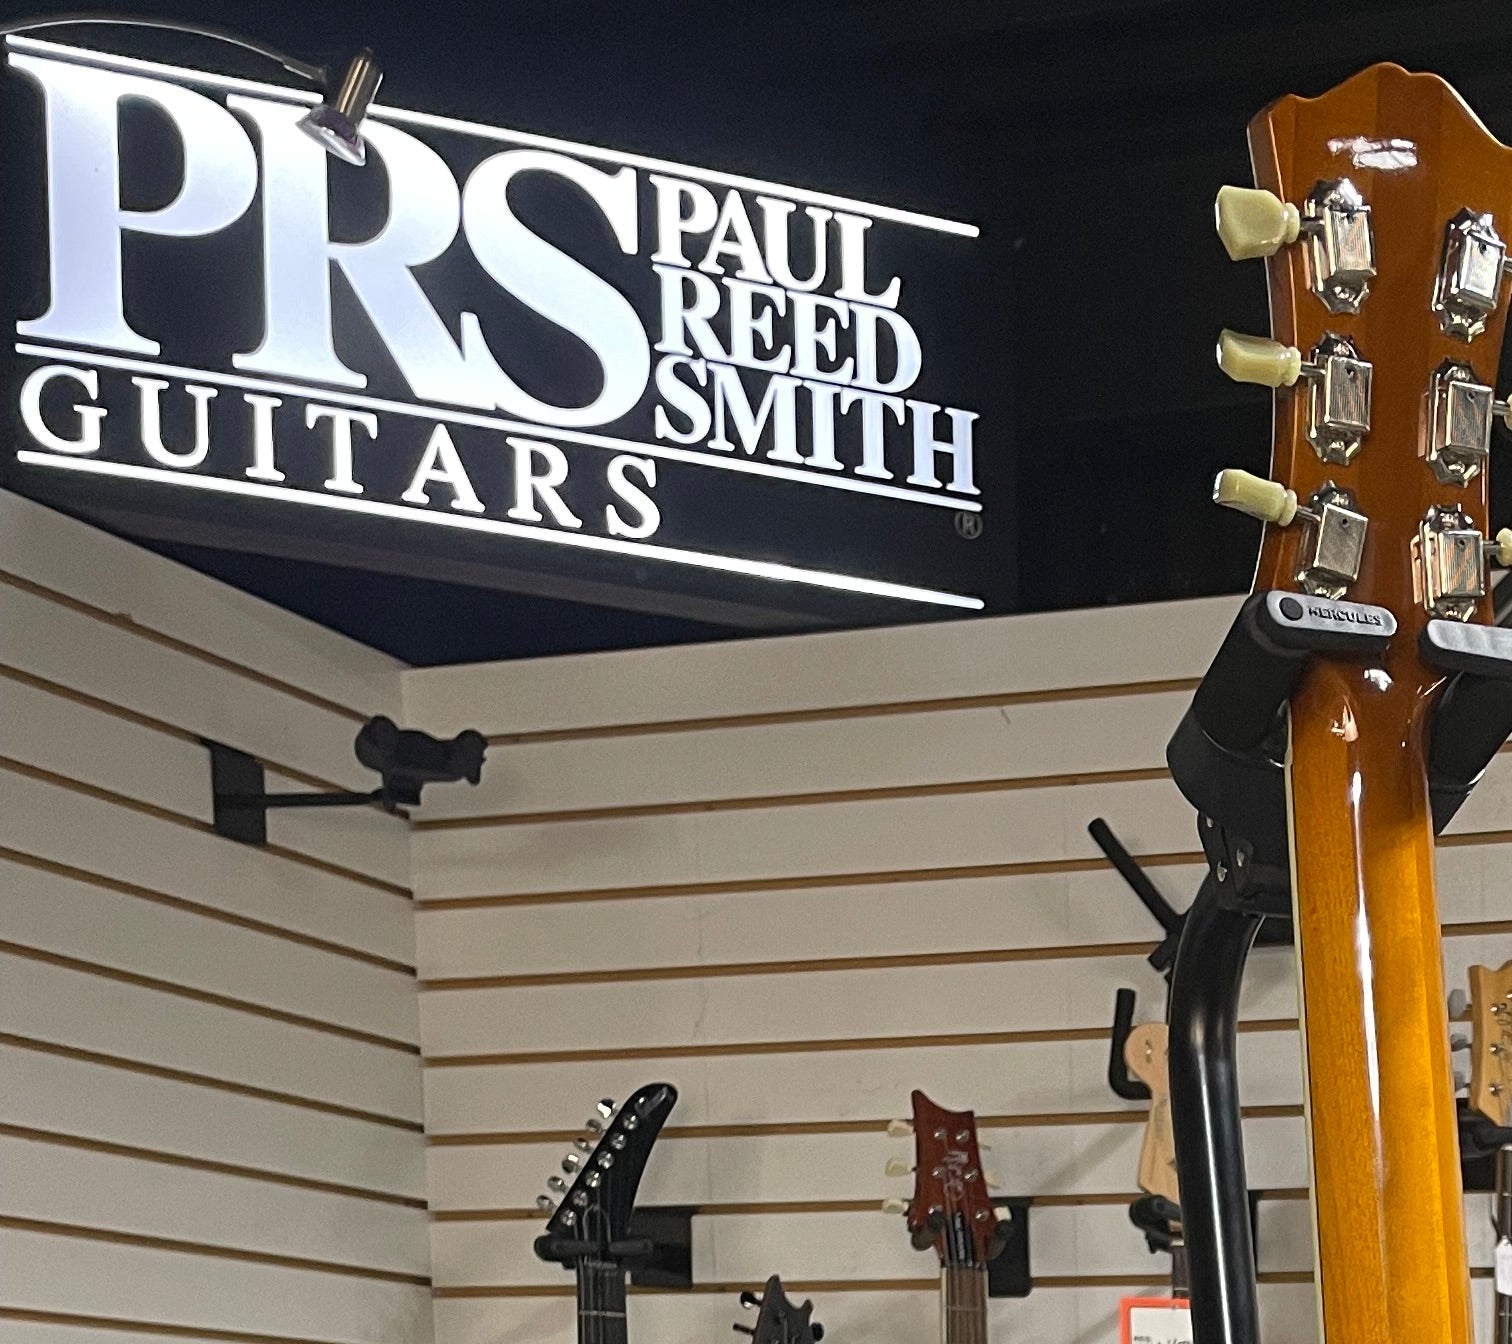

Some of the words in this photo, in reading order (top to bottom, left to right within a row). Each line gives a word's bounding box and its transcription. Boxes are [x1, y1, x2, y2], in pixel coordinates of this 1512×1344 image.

[6, 52, 651, 428] PRS
[649, 173, 901, 309] PAUL
[652, 263, 923, 395] REED
[16, 363, 661, 540] GUITARS
[654, 353, 981, 496] SMITH
[1308, 606, 1383, 626] HERCULES
